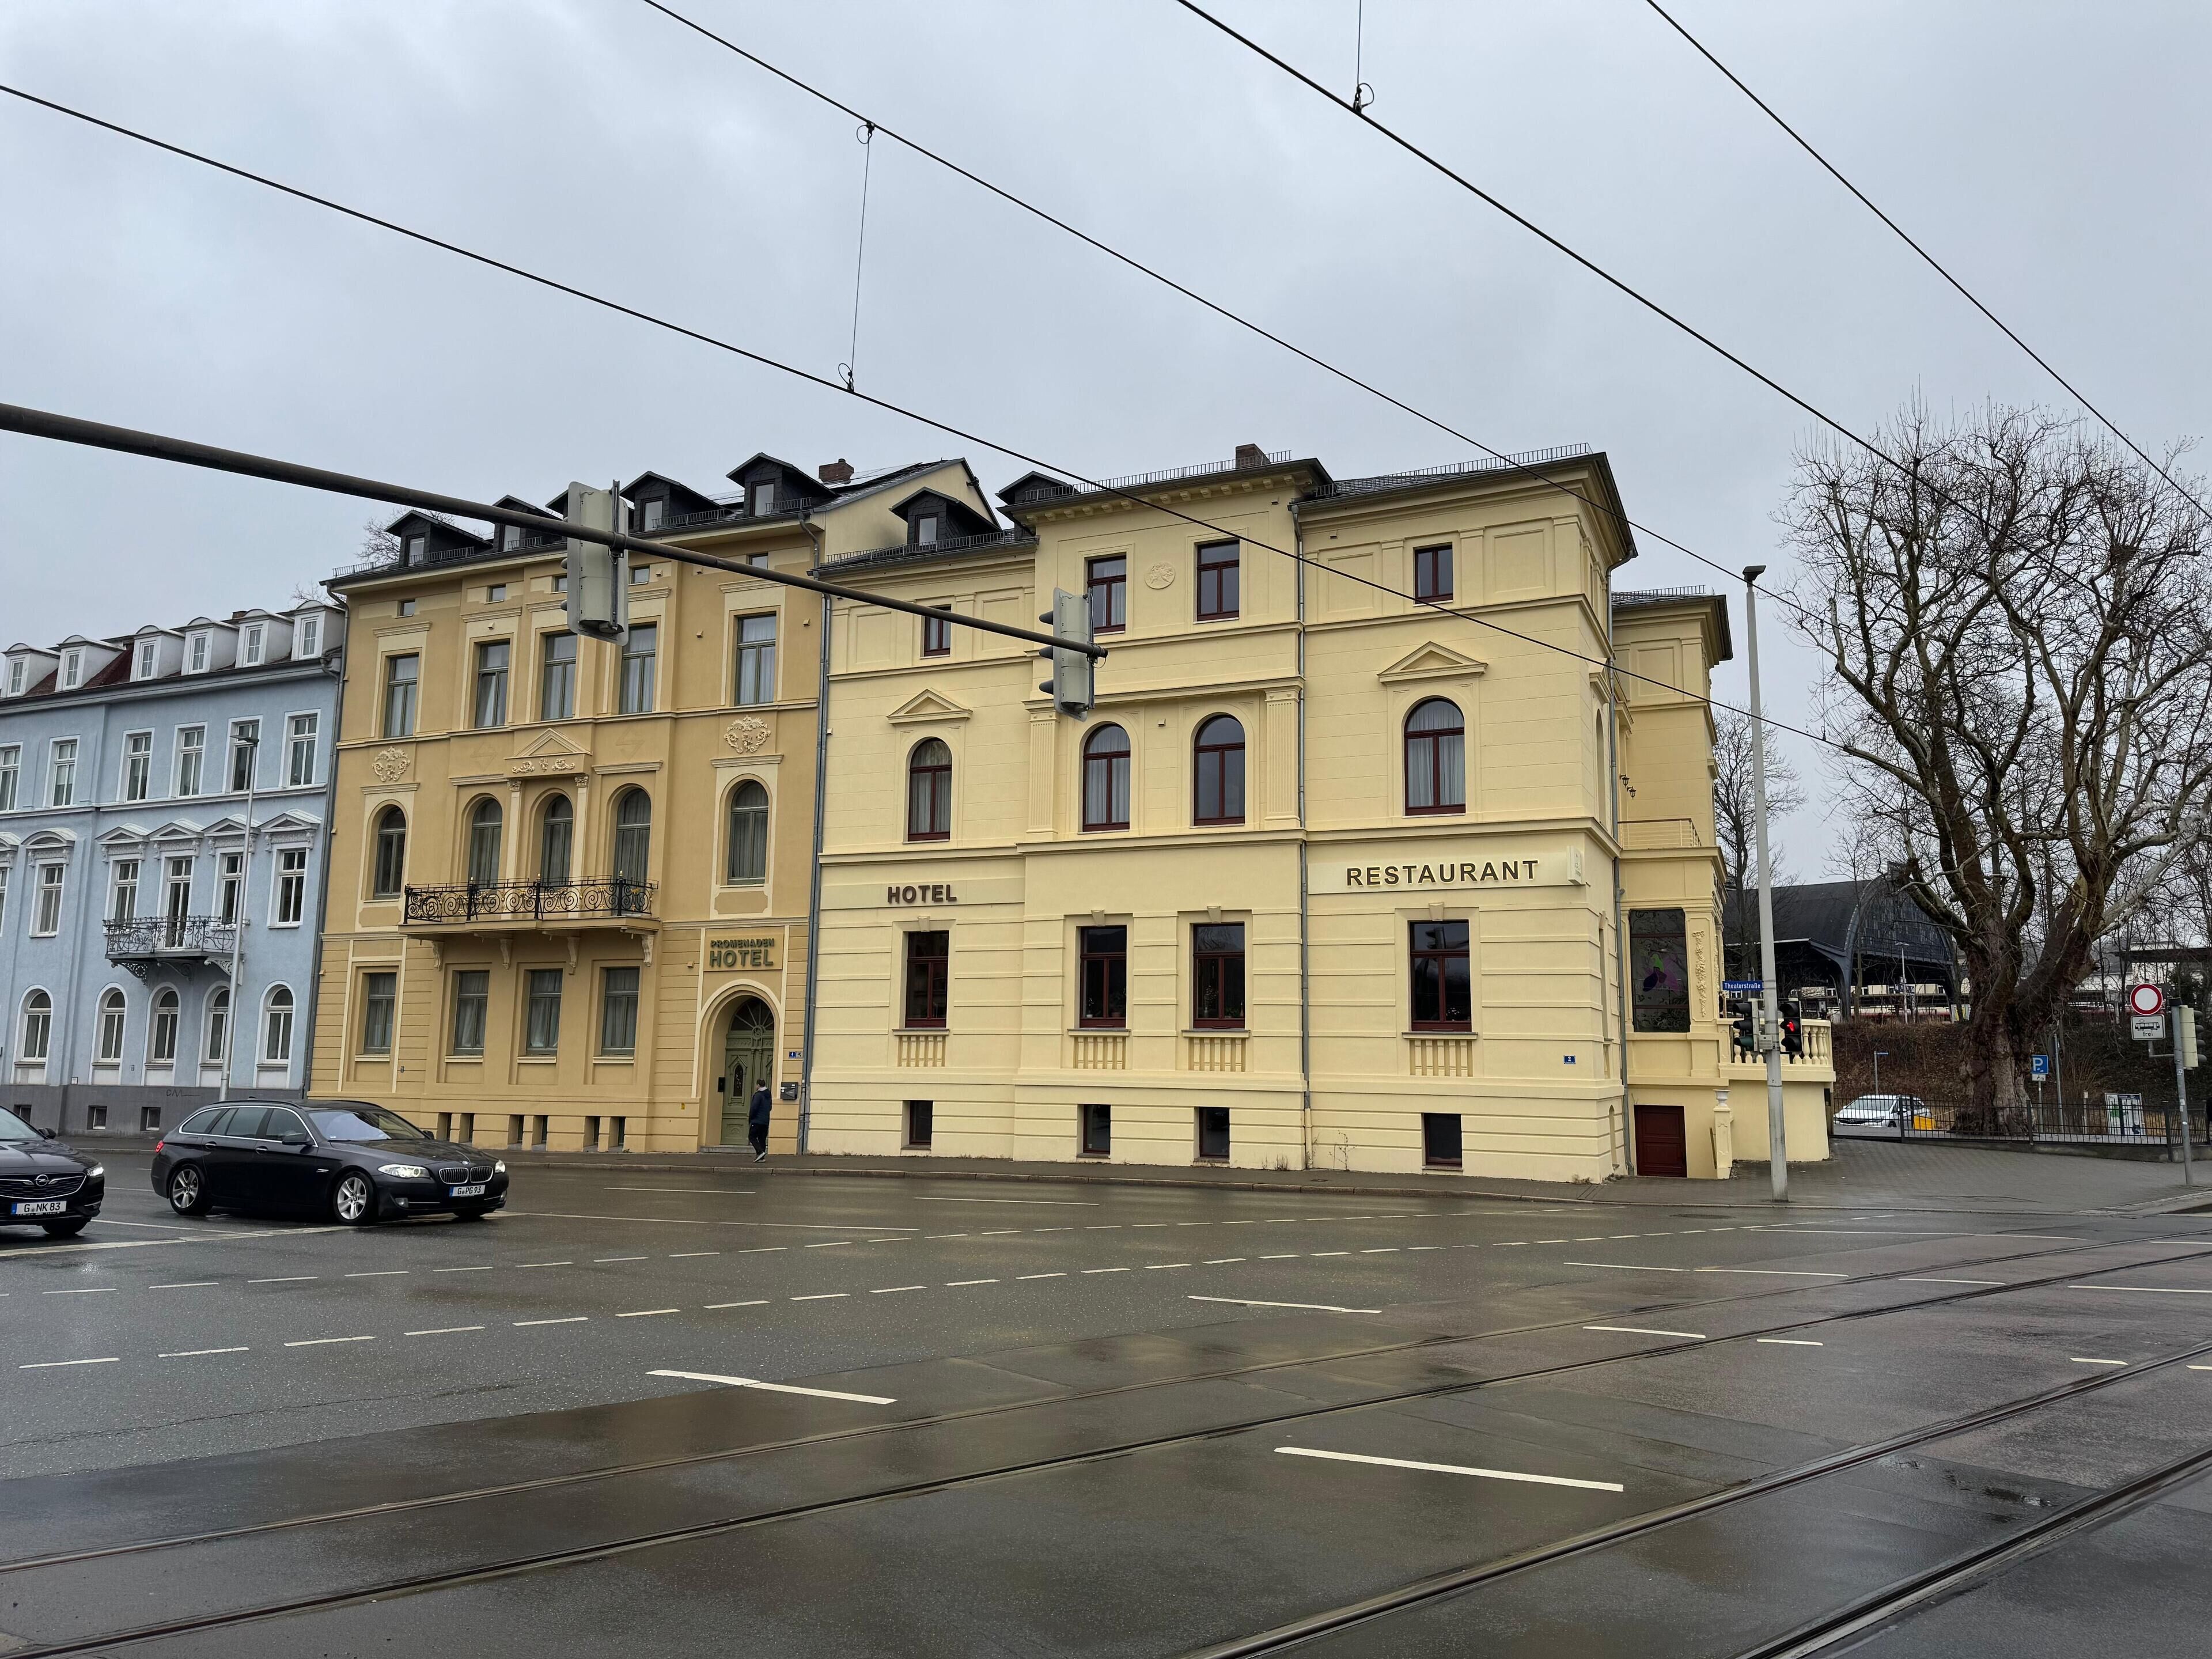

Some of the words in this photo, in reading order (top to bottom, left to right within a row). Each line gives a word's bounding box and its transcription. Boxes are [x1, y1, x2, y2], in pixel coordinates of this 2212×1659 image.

[1347, 860, 1539, 886] RESTAURANT
[887, 884, 957, 904] HOTEL
[710, 938, 775, 948] PROMENADEN
[710, 949, 774, 967] HOTEL
[2032, 1058, 2043, 1071] P
[36, 1203, 48, 1211] NK
[50, 1203, 60, 1211] 83
